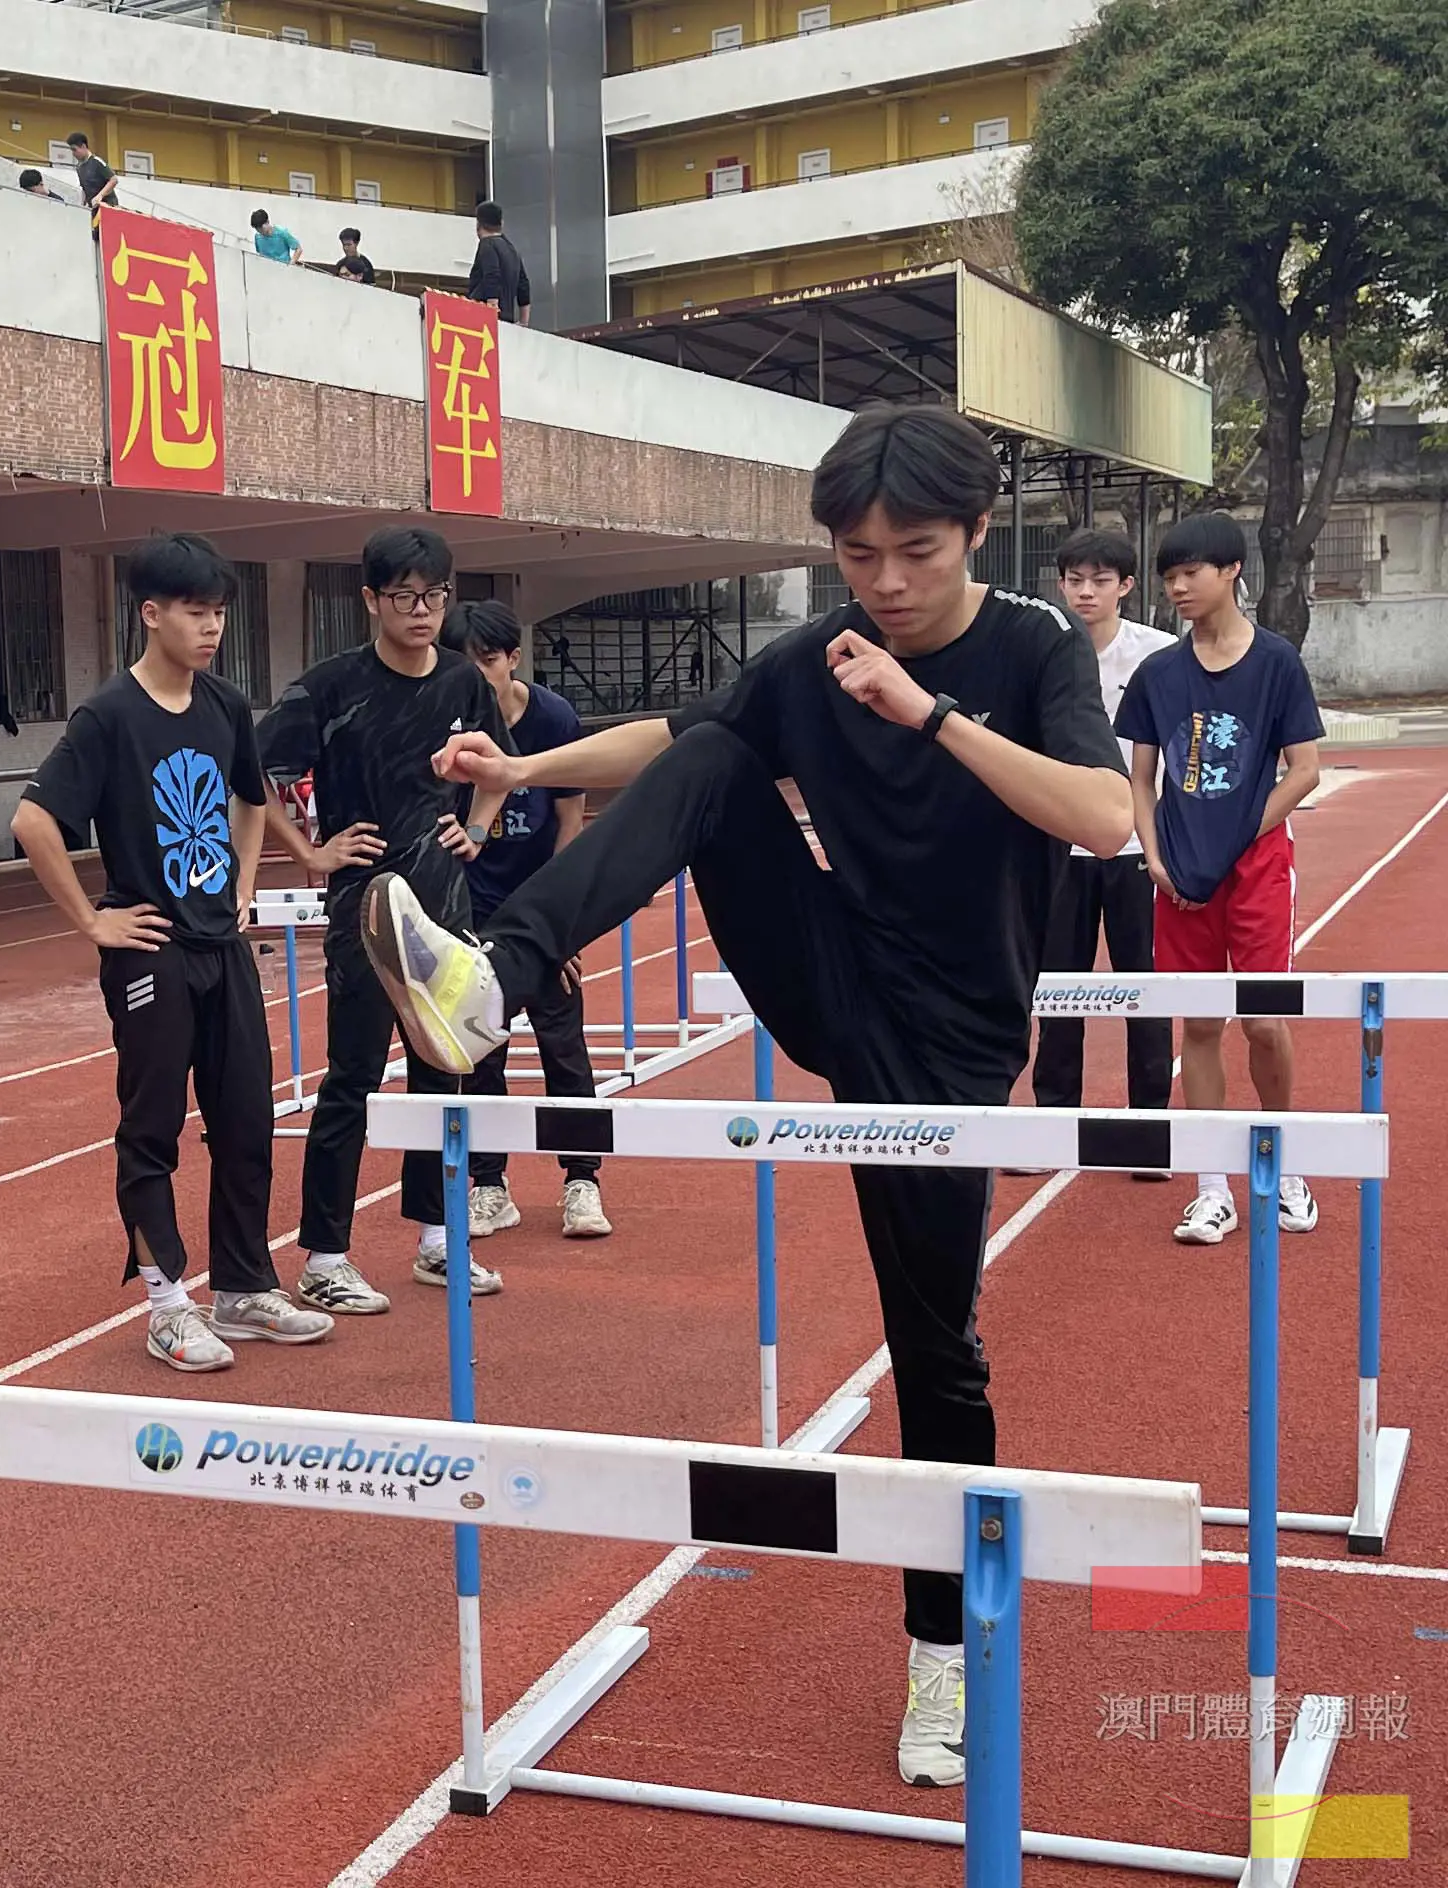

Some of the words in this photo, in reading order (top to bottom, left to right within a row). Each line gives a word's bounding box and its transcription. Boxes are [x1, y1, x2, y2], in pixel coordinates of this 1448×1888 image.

[112, 232, 216, 469] 冠
[431, 311, 496, 498] 军
[1034, 985, 1140, 1004] werbridge
[250, 1471, 419, 1503] 北京博祥恒瑞体育
